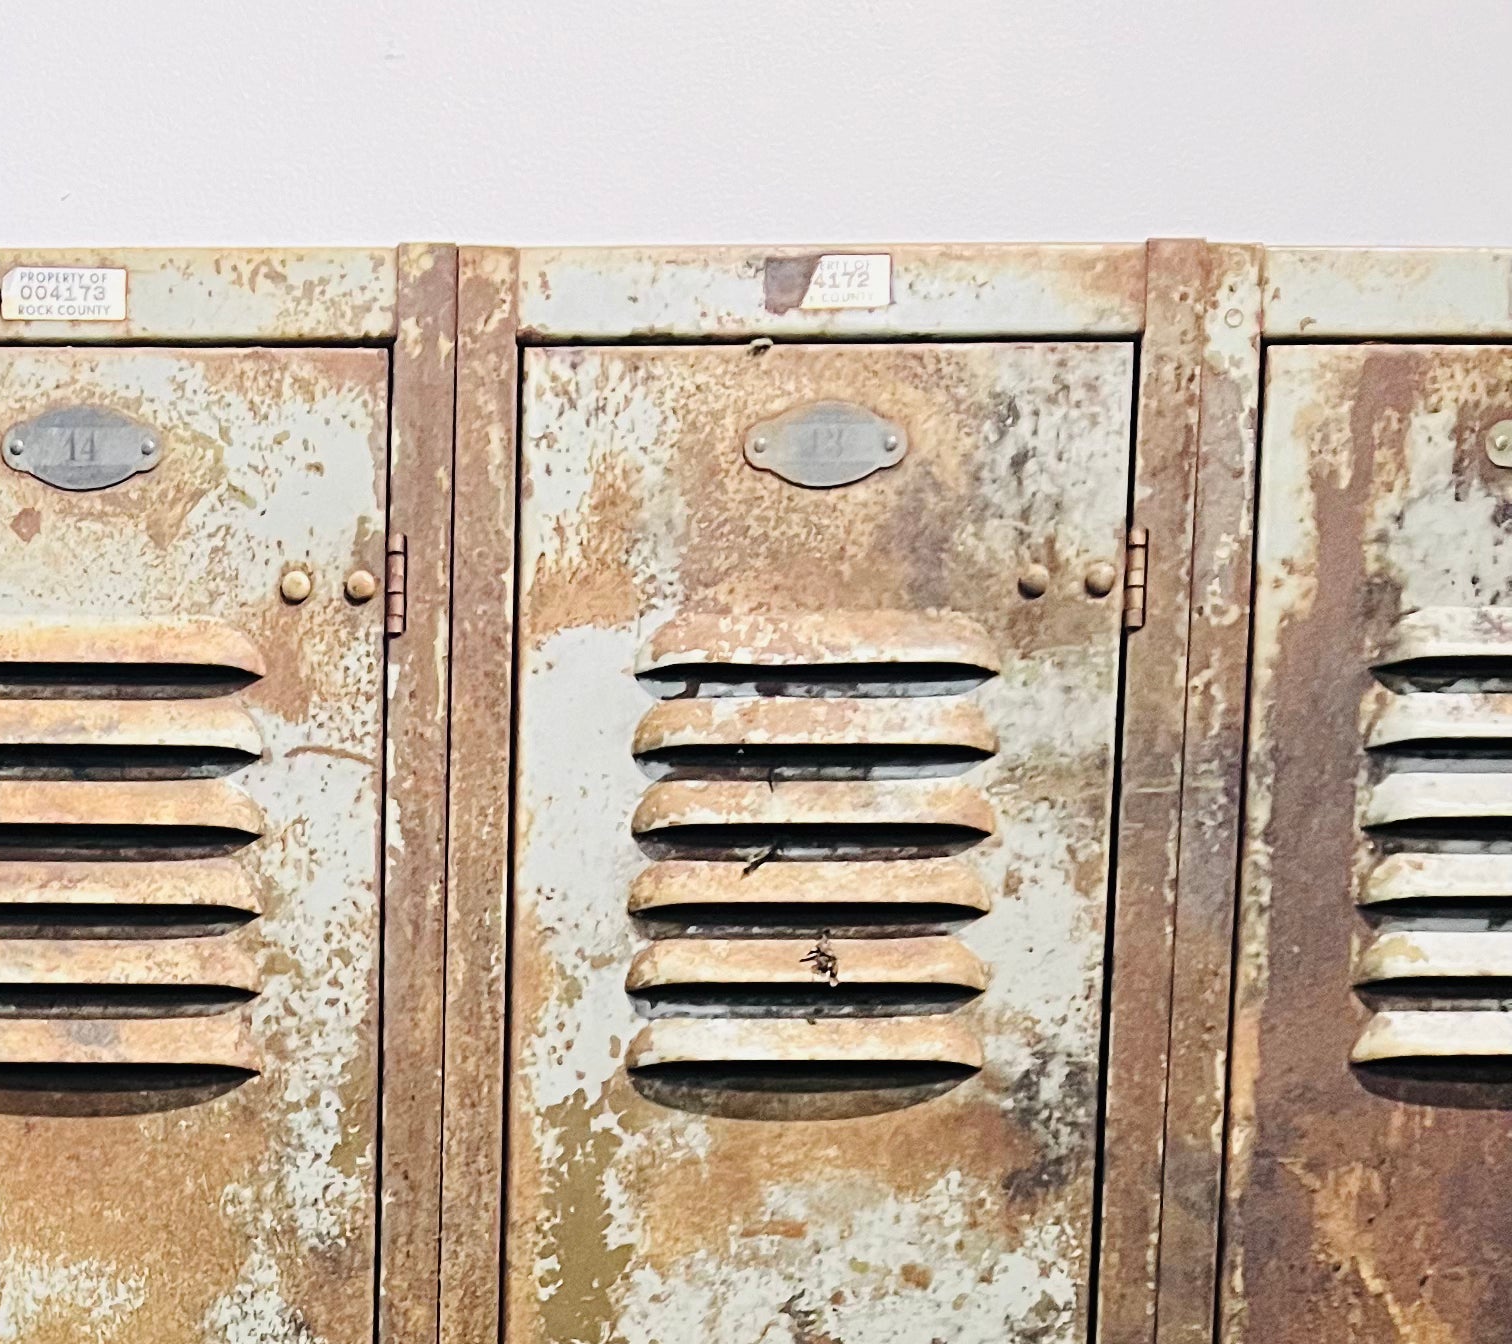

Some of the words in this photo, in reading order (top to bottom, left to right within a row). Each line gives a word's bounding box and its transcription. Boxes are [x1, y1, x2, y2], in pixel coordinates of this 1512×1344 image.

[20, 271, 85, 284] PROPERTY
[89, 272, 108, 284] OF
[20, 285, 106, 302] 004173
[822, 291, 874, 303] COUNTY
[18, 305, 54, 316] ROCK
[57, 305, 111, 316] COUNTY
[62, 429, 97, 463] 14
